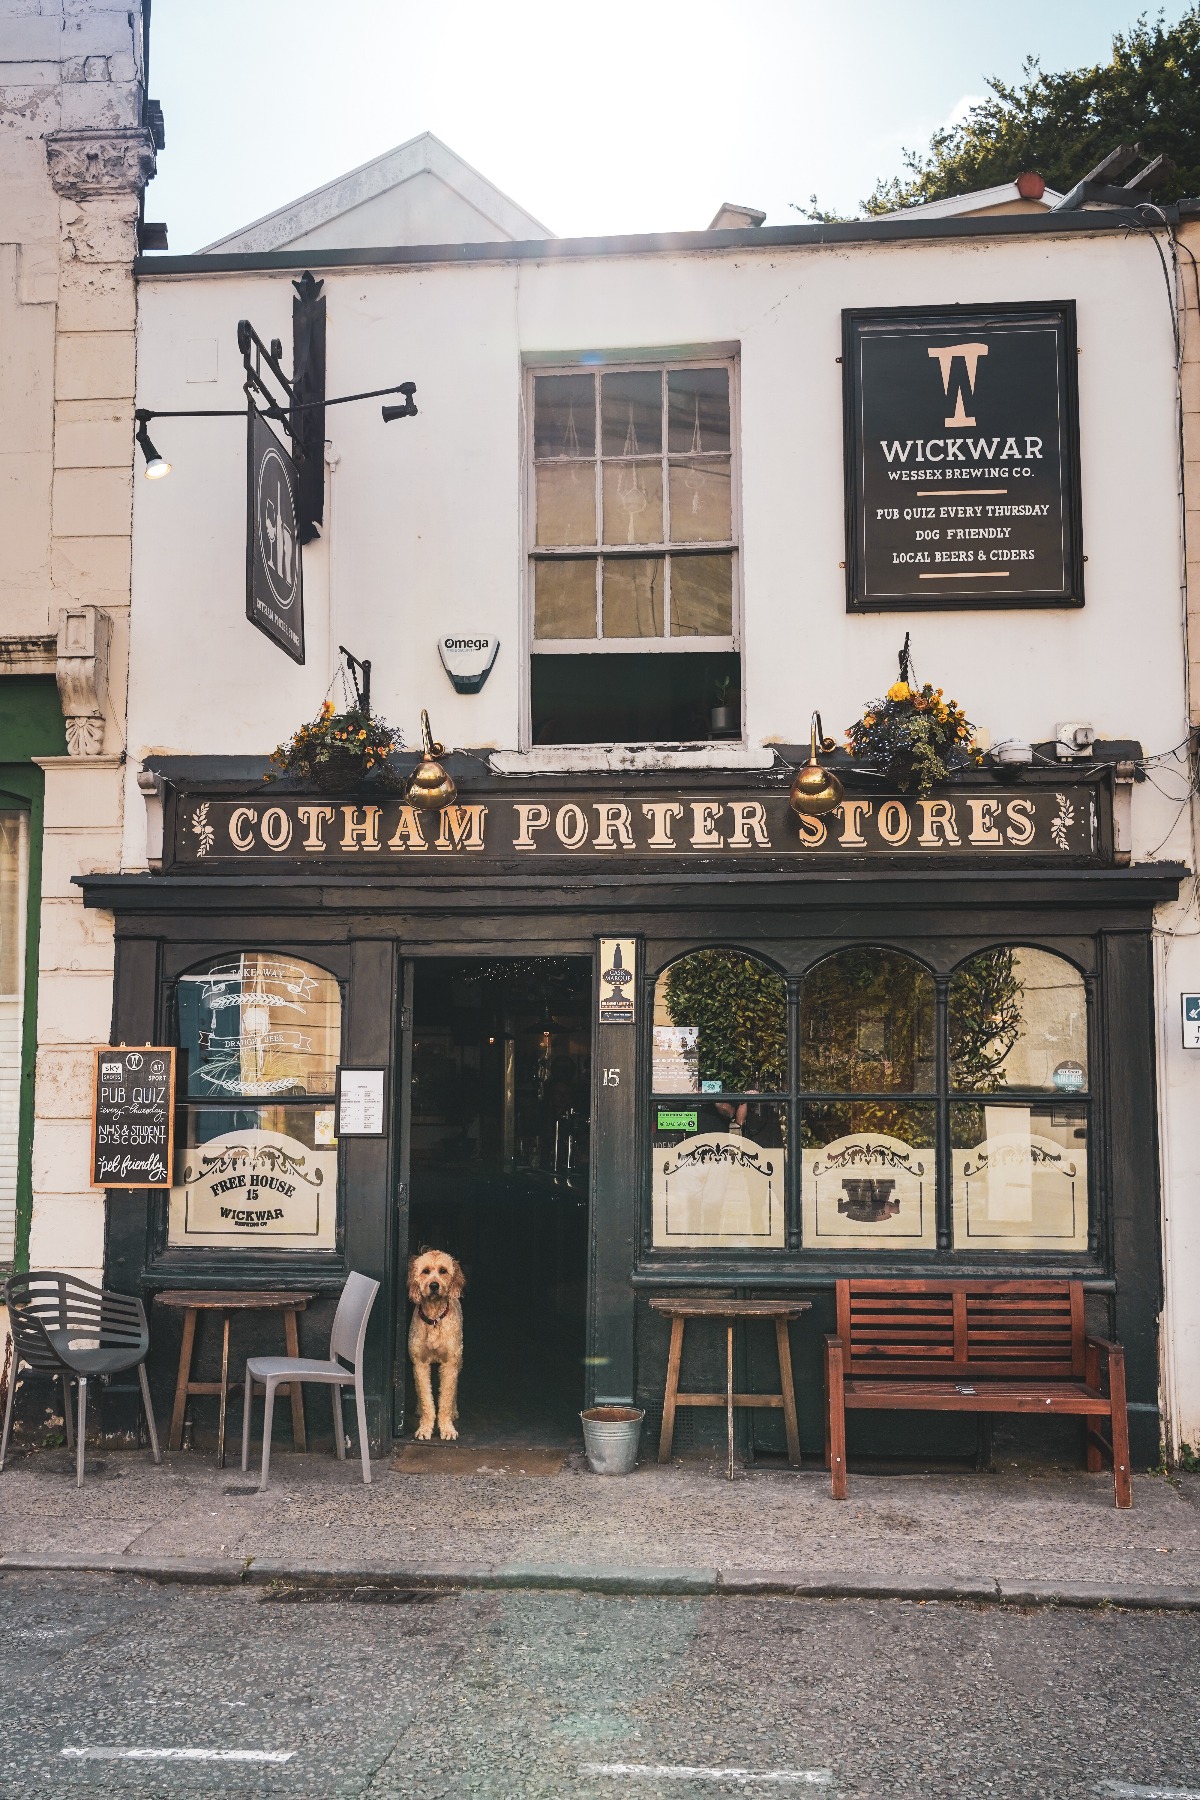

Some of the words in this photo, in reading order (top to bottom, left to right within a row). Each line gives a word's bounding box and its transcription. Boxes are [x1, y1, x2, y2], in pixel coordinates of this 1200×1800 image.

[879, 436, 1044, 463] WICKWAR
[888, 469, 942, 481] WESSEX
[945, 467, 1009, 480] BREWING
[1012, 467, 1035, 478] CO.
[876, 508, 900, 520] PUB
[903, 507, 936, 520] QUIZ
[939, 505, 983, 518] EVERY
[985, 504, 1050, 517] THURSDAY
[915, 529, 940, 541] DOG
[946, 526, 1012, 540] FRIENDLY
[892, 552, 931, 564] LOCAL
[934, 550, 975, 563] BEERS
[977, 550, 987, 561] &
[989, 549, 1035, 562] CIDERS
[444, 638, 489, 651] Omega
[228, 805, 488, 853] COTHAM
[512, 801, 773, 852] PORTER
[798, 798, 1037, 848] STORES
[224, 1037, 263, 1048] DRAUGH
[263, 1034, 285, 1043] BEER
[603, 1069, 620, 1087] 15
[101, 1088, 126, 1103] PUB
[132, 1088, 165, 1104] QUIZ
[99, 1125, 120, 1135] NHS
[131, 1125, 165, 1136] STUDENT
[99, 1135, 166, 1145] DISCOUNT
[100, 1154, 121, 1180] pet
[120, 1153, 165, 1181] friendly
[210, 1175, 247, 1197] FREE
[250, 1175, 296, 1198] HOUSE
[246, 1189, 259, 1201] 15
[220, 1207, 284, 1222] WICKWAR
